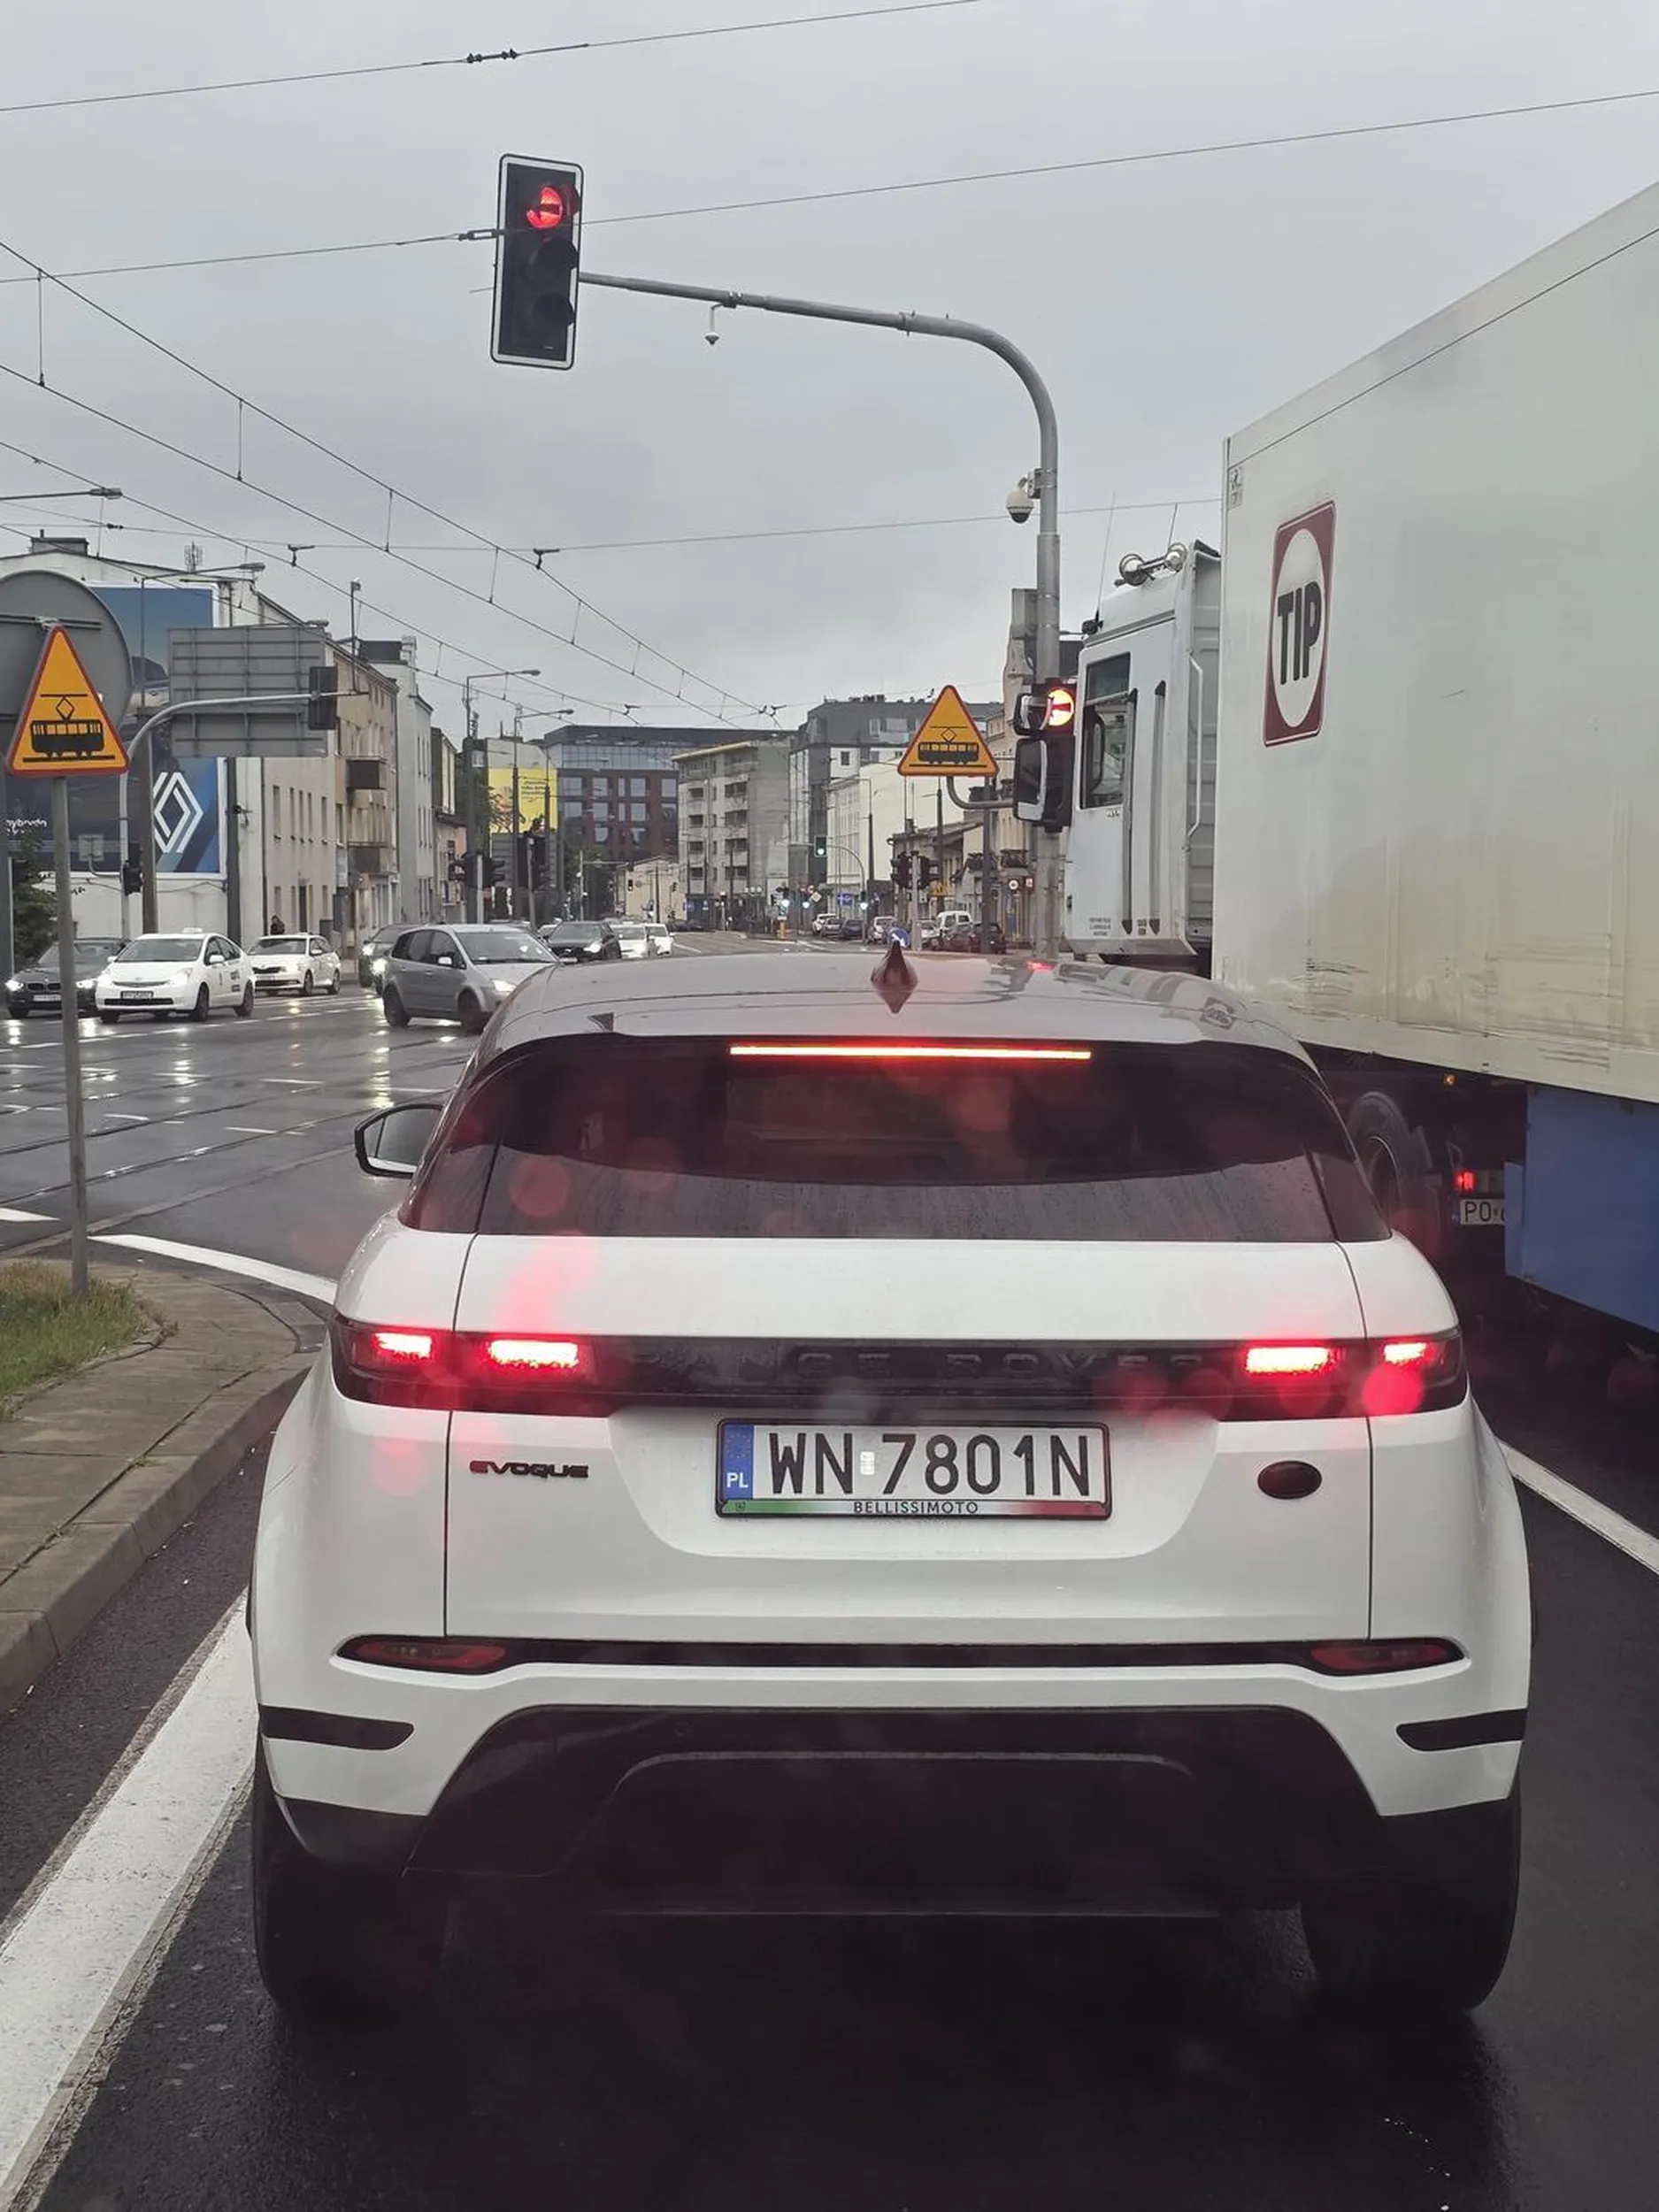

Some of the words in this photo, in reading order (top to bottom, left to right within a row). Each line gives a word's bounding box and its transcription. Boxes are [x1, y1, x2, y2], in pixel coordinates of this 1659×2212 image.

[1278, 580, 1322, 686] TIP
[469, 1460, 589, 1479] EVOQUE
[769, 1432, 853, 1494] WN
[882, 1433, 1090, 1497] 7801N
[726, 1472, 749, 1488] PL
[853, 1501, 979, 1515] BELLISSIMOTO
